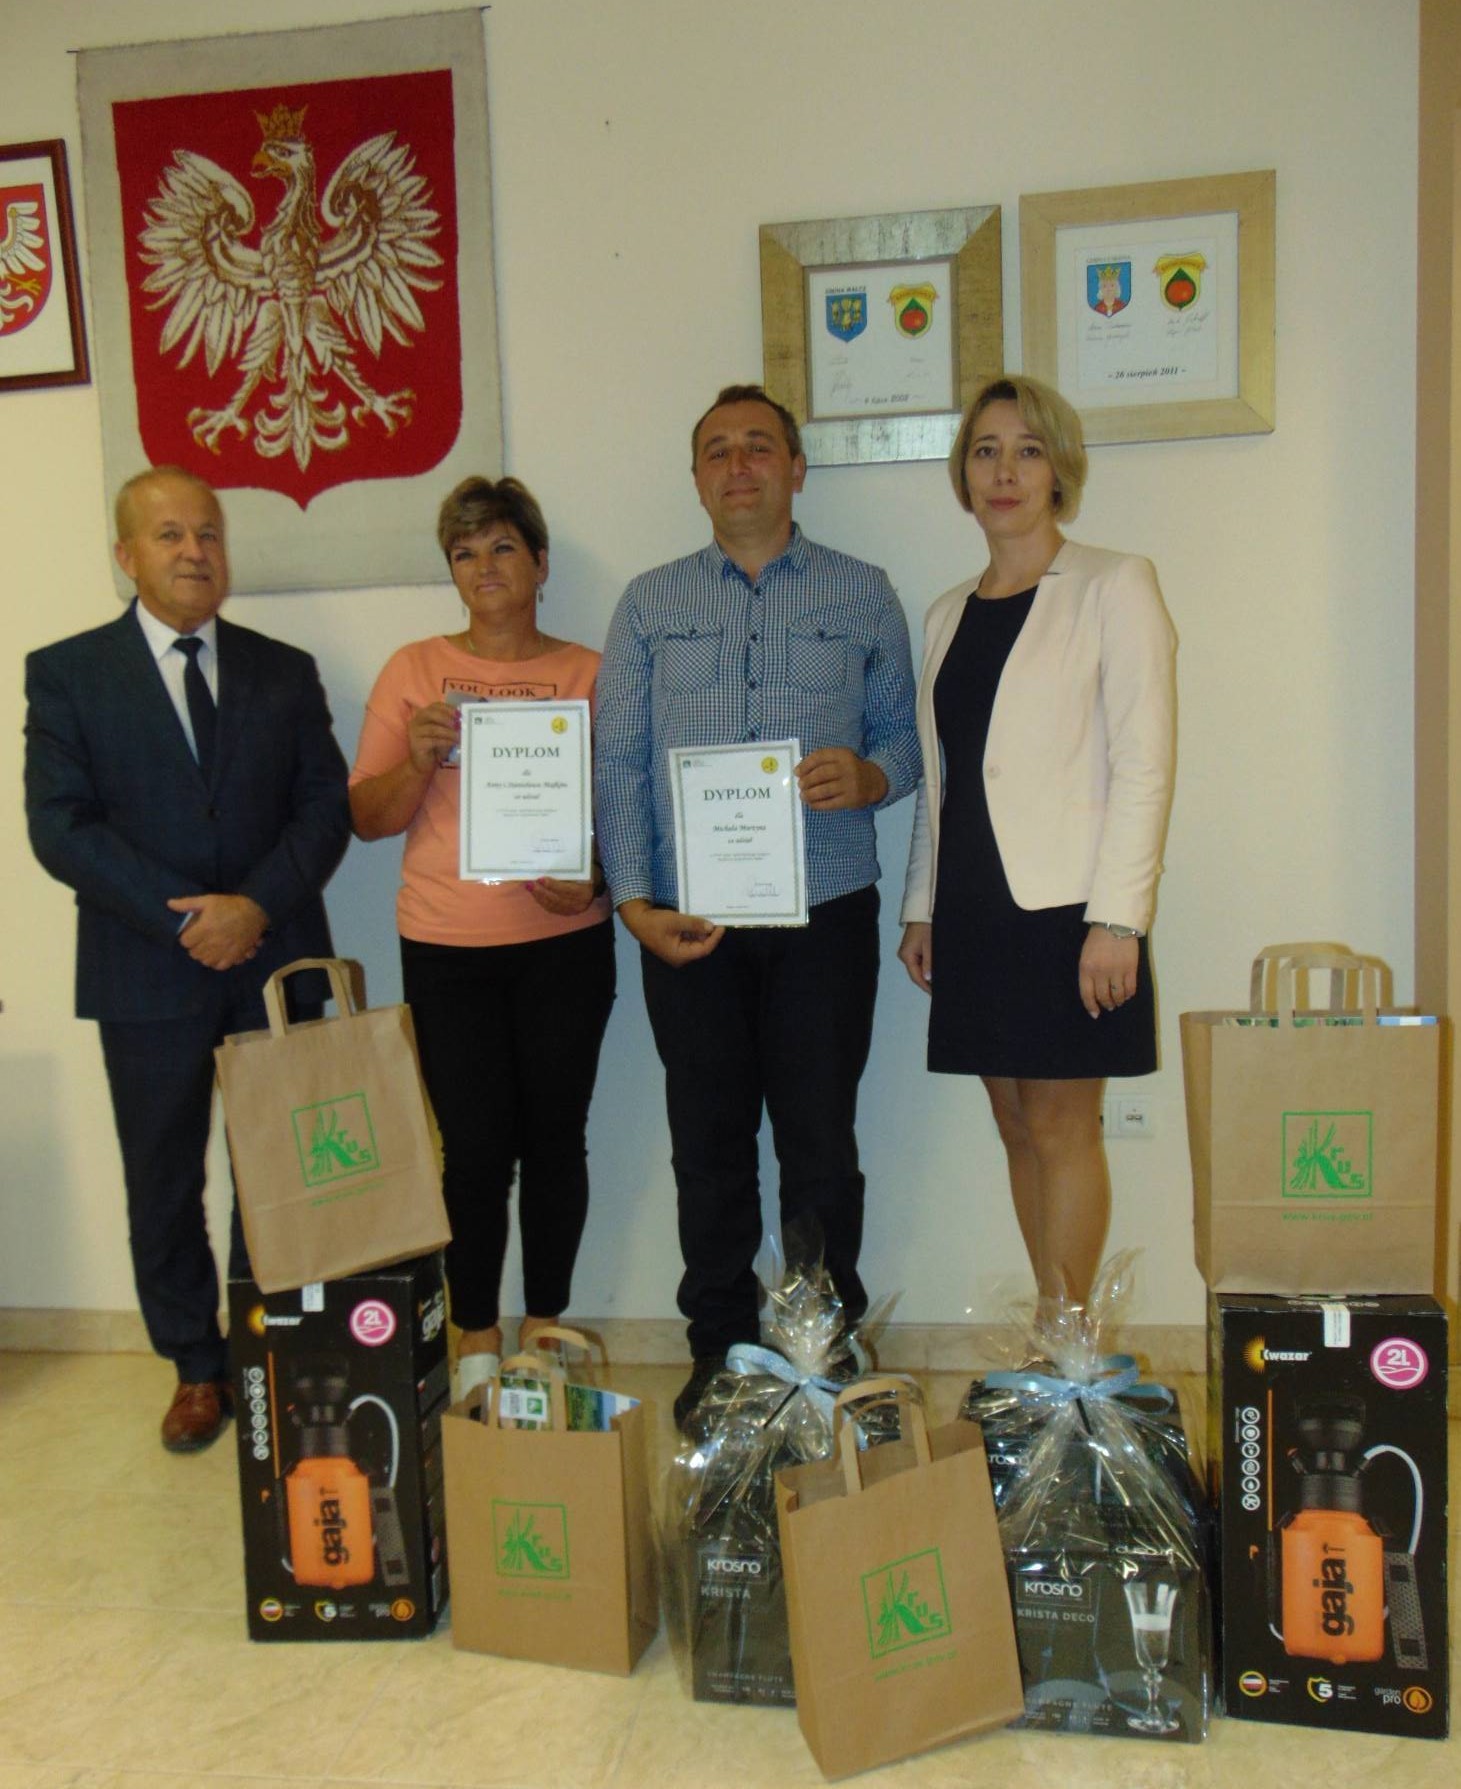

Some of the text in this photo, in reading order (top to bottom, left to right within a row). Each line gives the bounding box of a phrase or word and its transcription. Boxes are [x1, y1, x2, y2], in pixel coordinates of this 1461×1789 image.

[1160, 366, 1179, 376] 2011
[488, 686, 536, 698] LOOK
[492, 747, 560, 758] DYPLOM
[704, 787, 771, 801] DYPLOM
[313, 1500, 349, 1566] gaja
[701, 1584, 751, 1599] KRISTA
[1024, 1580, 1083, 1598] krosno
[1313, 1557, 1355, 1637] gaja
[1016, 1608, 1096, 1623] KRISTA DECO
[1318, 1683, 1334, 1698] 5
[1383, 1695, 1401, 1706] pro
